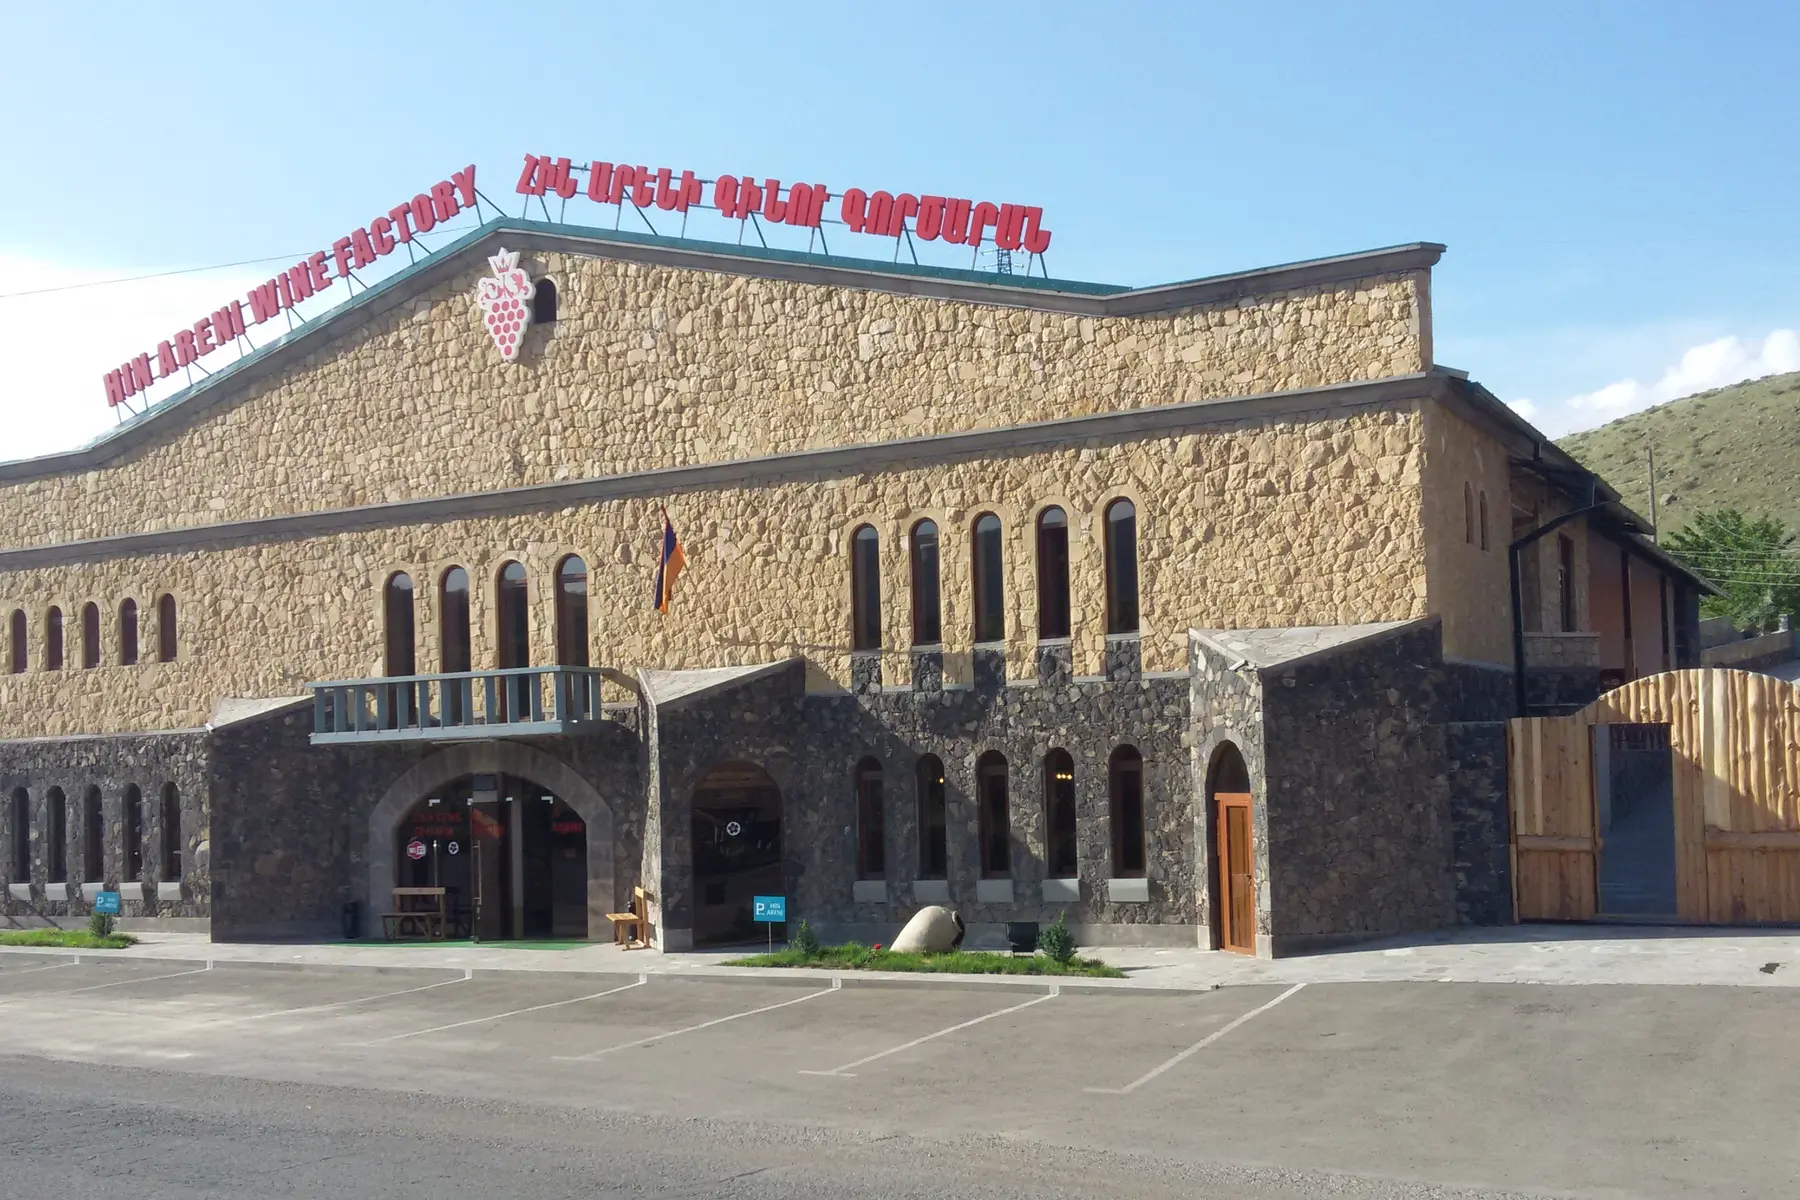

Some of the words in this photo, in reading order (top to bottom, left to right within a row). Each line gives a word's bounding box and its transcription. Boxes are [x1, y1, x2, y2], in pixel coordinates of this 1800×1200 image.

[103, 352, 154, 407] HIN
[157, 300, 246, 378] ARENI
[247, 250, 333, 324] WINE
[332, 164, 477, 278] FACTORY
[516, 153, 578, 199] ՀԻՆ
[588, 160, 703, 212] ԱՐԵՆԻ
[714, 175, 830, 228] ԳԻՆՈՒ
[841, 188, 1051, 254] ԳՈՐԾԱՐԱՆ
